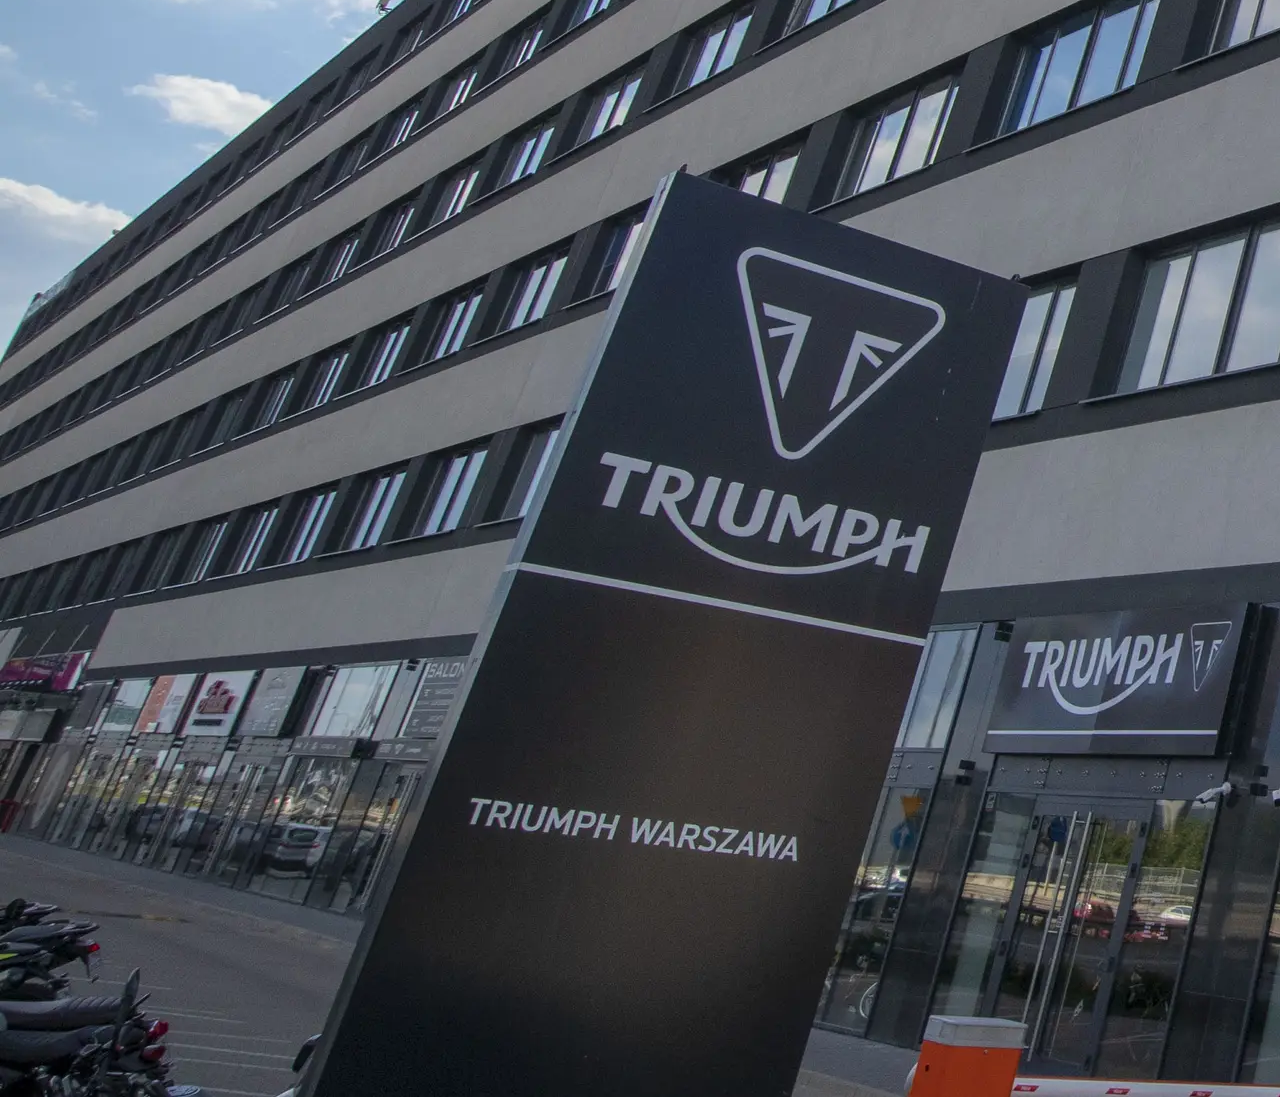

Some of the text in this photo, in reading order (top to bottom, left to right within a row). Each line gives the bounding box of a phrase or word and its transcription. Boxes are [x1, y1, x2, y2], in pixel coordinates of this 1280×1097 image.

[599, 451, 930, 576] TRIUMPH
[1021, 632, 1184, 715] TRIUMPH
[468, 797, 800, 863] TRIUMPH WARSZAWA
